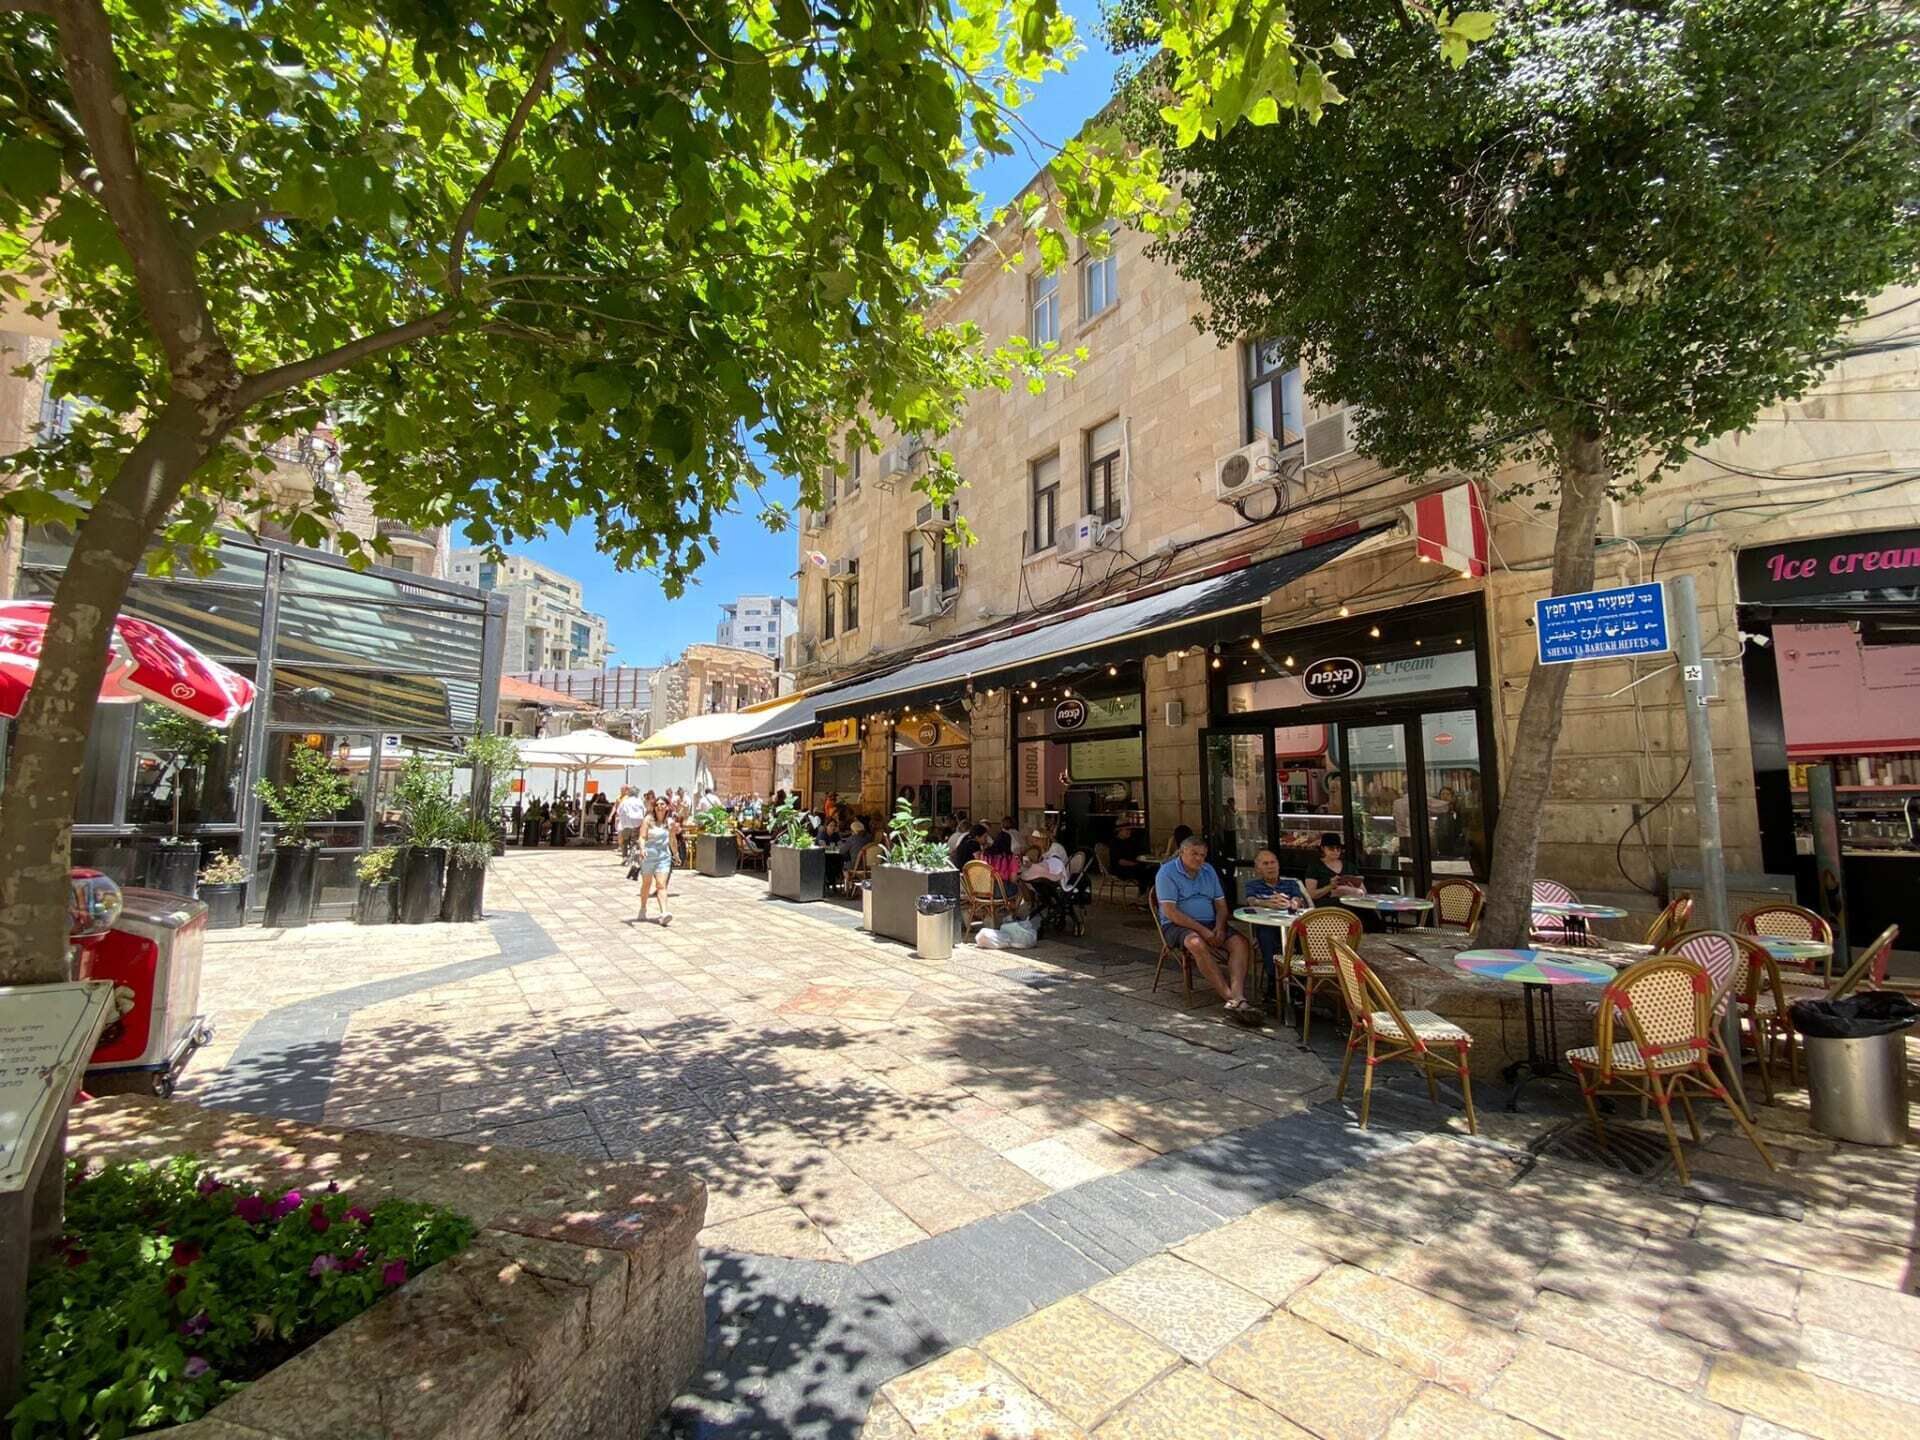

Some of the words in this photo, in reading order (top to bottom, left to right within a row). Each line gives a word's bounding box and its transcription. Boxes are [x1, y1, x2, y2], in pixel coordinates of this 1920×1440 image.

[1767, 553, 1817, 581] Ice
[1310, 668, 1354, 685] קצפת
[1057, 708, 1080, 720] קצפת
[1025, 746, 1039, 797] YOGURT
